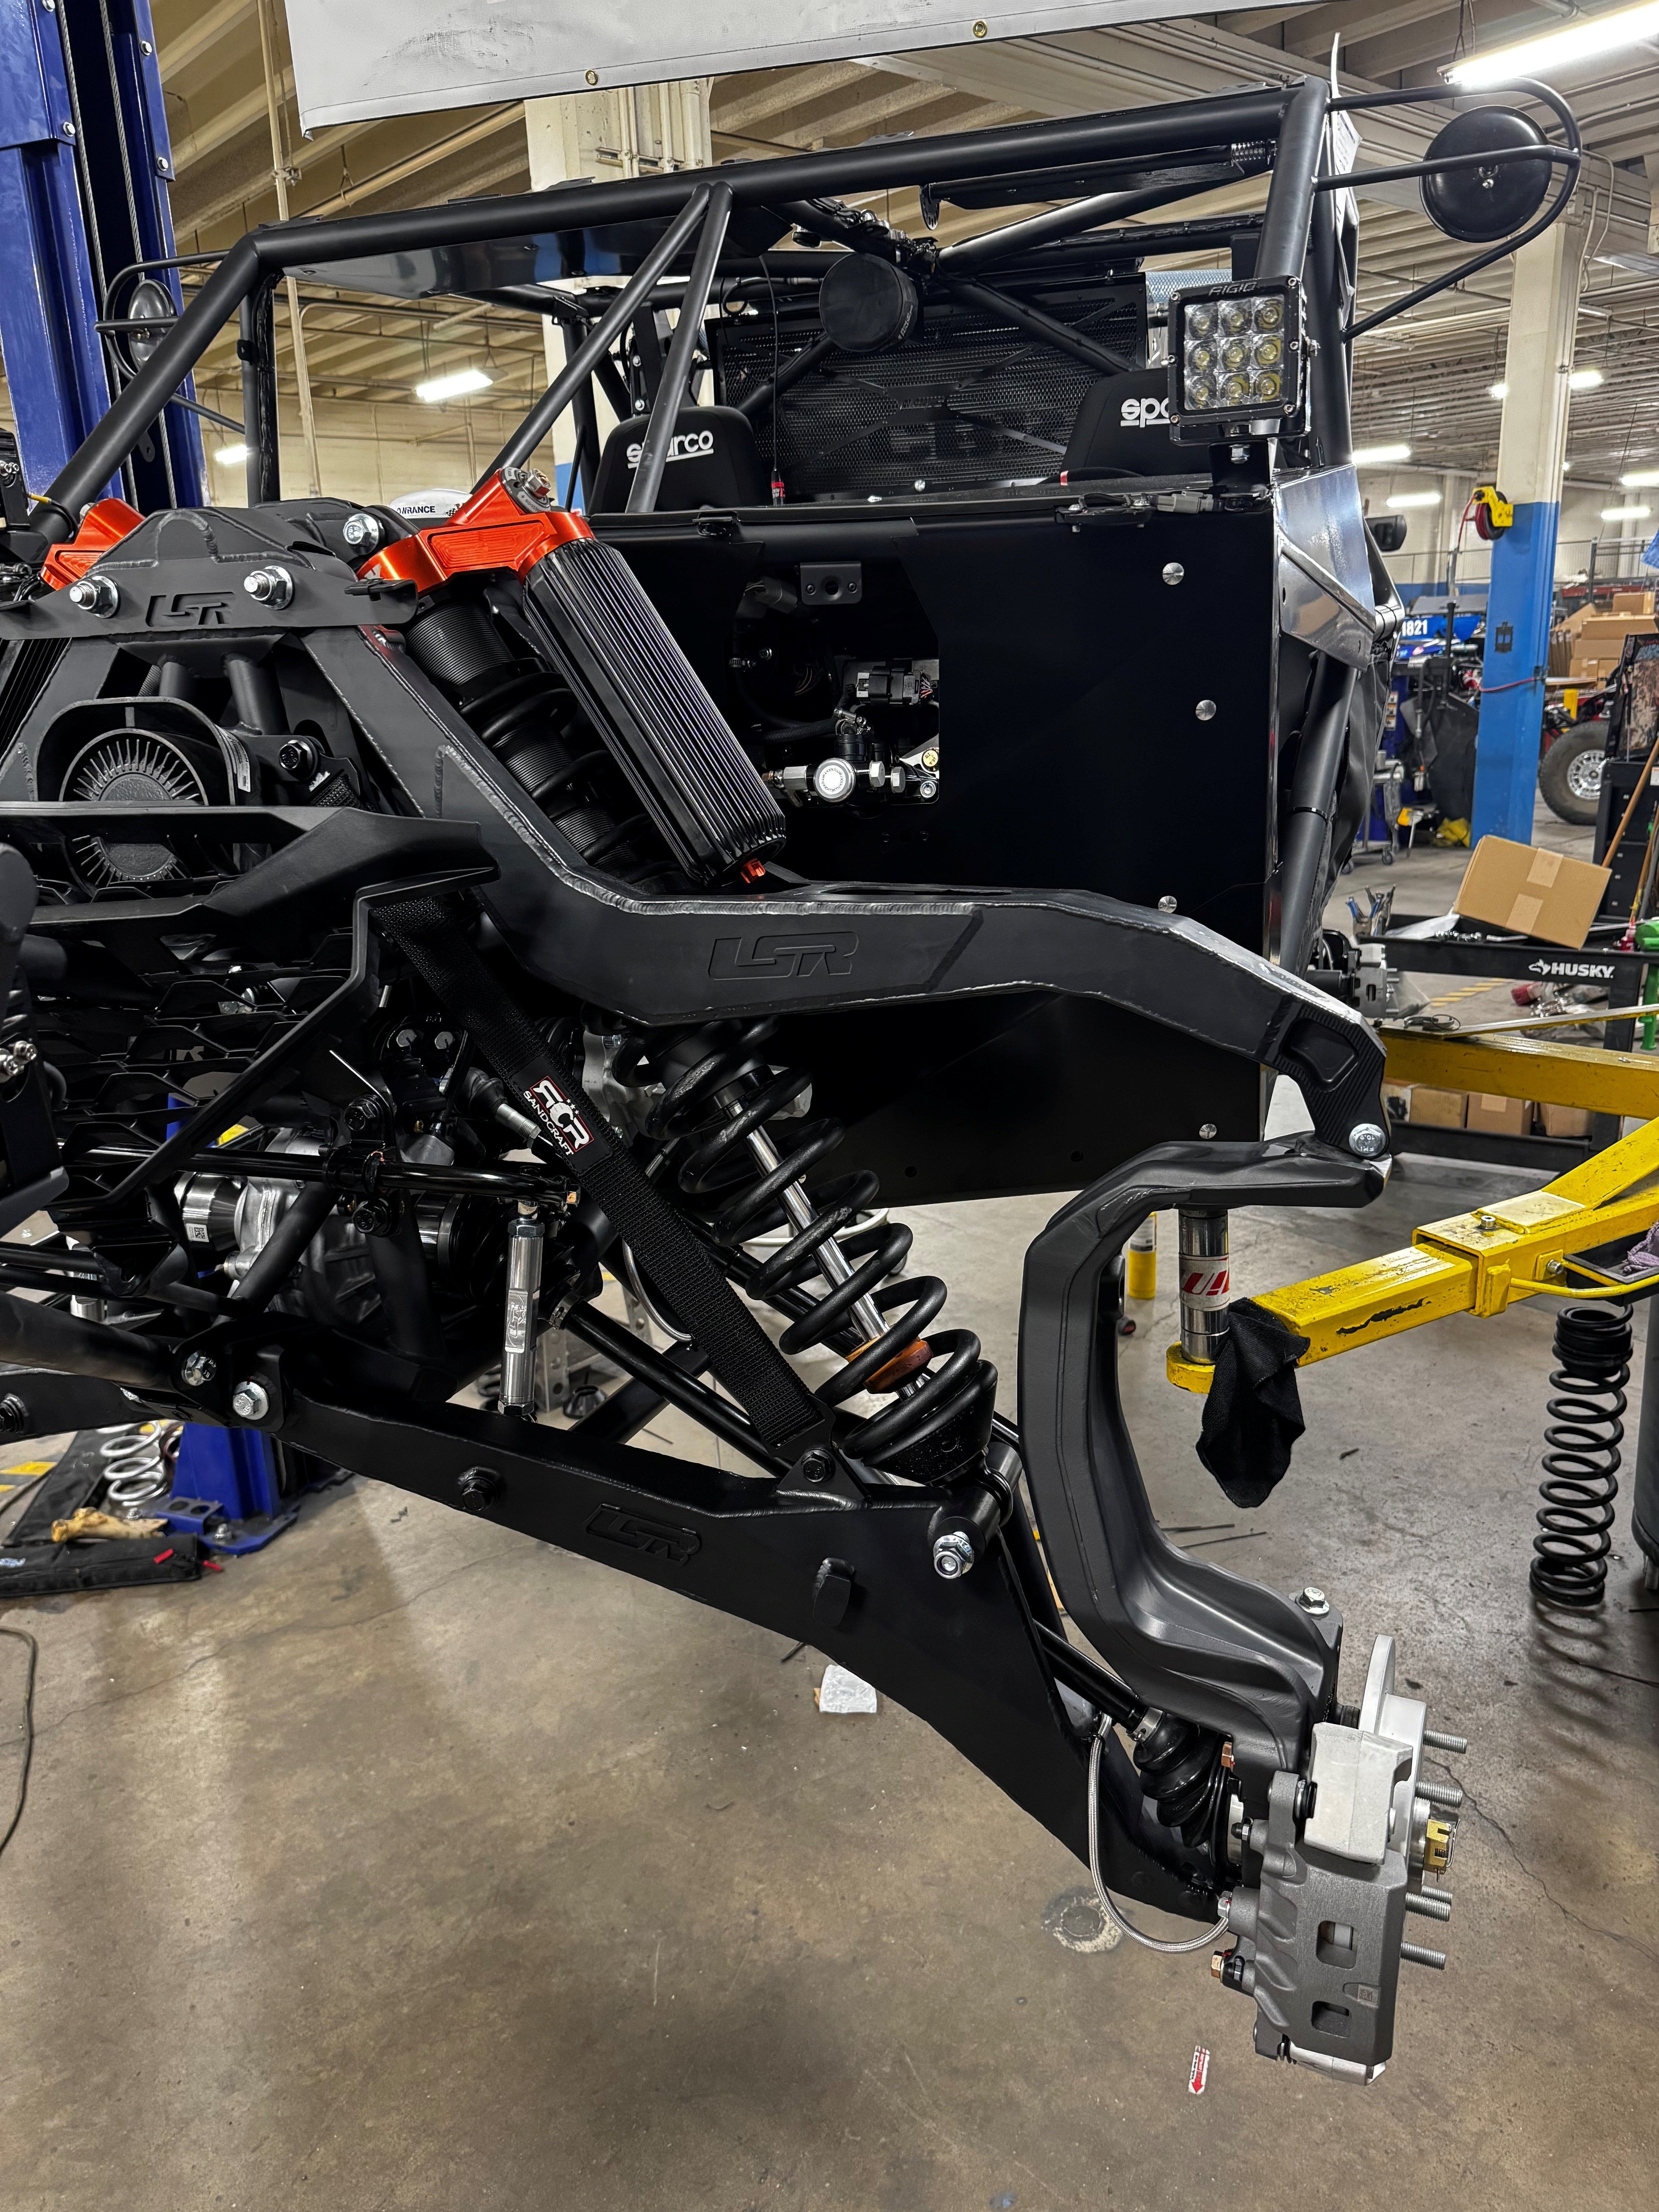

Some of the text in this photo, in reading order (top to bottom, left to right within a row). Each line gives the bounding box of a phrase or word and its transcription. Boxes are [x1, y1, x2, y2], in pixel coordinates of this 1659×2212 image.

[1208, 282, 1257, 296] RIGID
[626, 430, 713, 463] srco
[1401, 619, 1428, 637] 1821
[523, 1090, 574, 1156] SANDCRAFT
